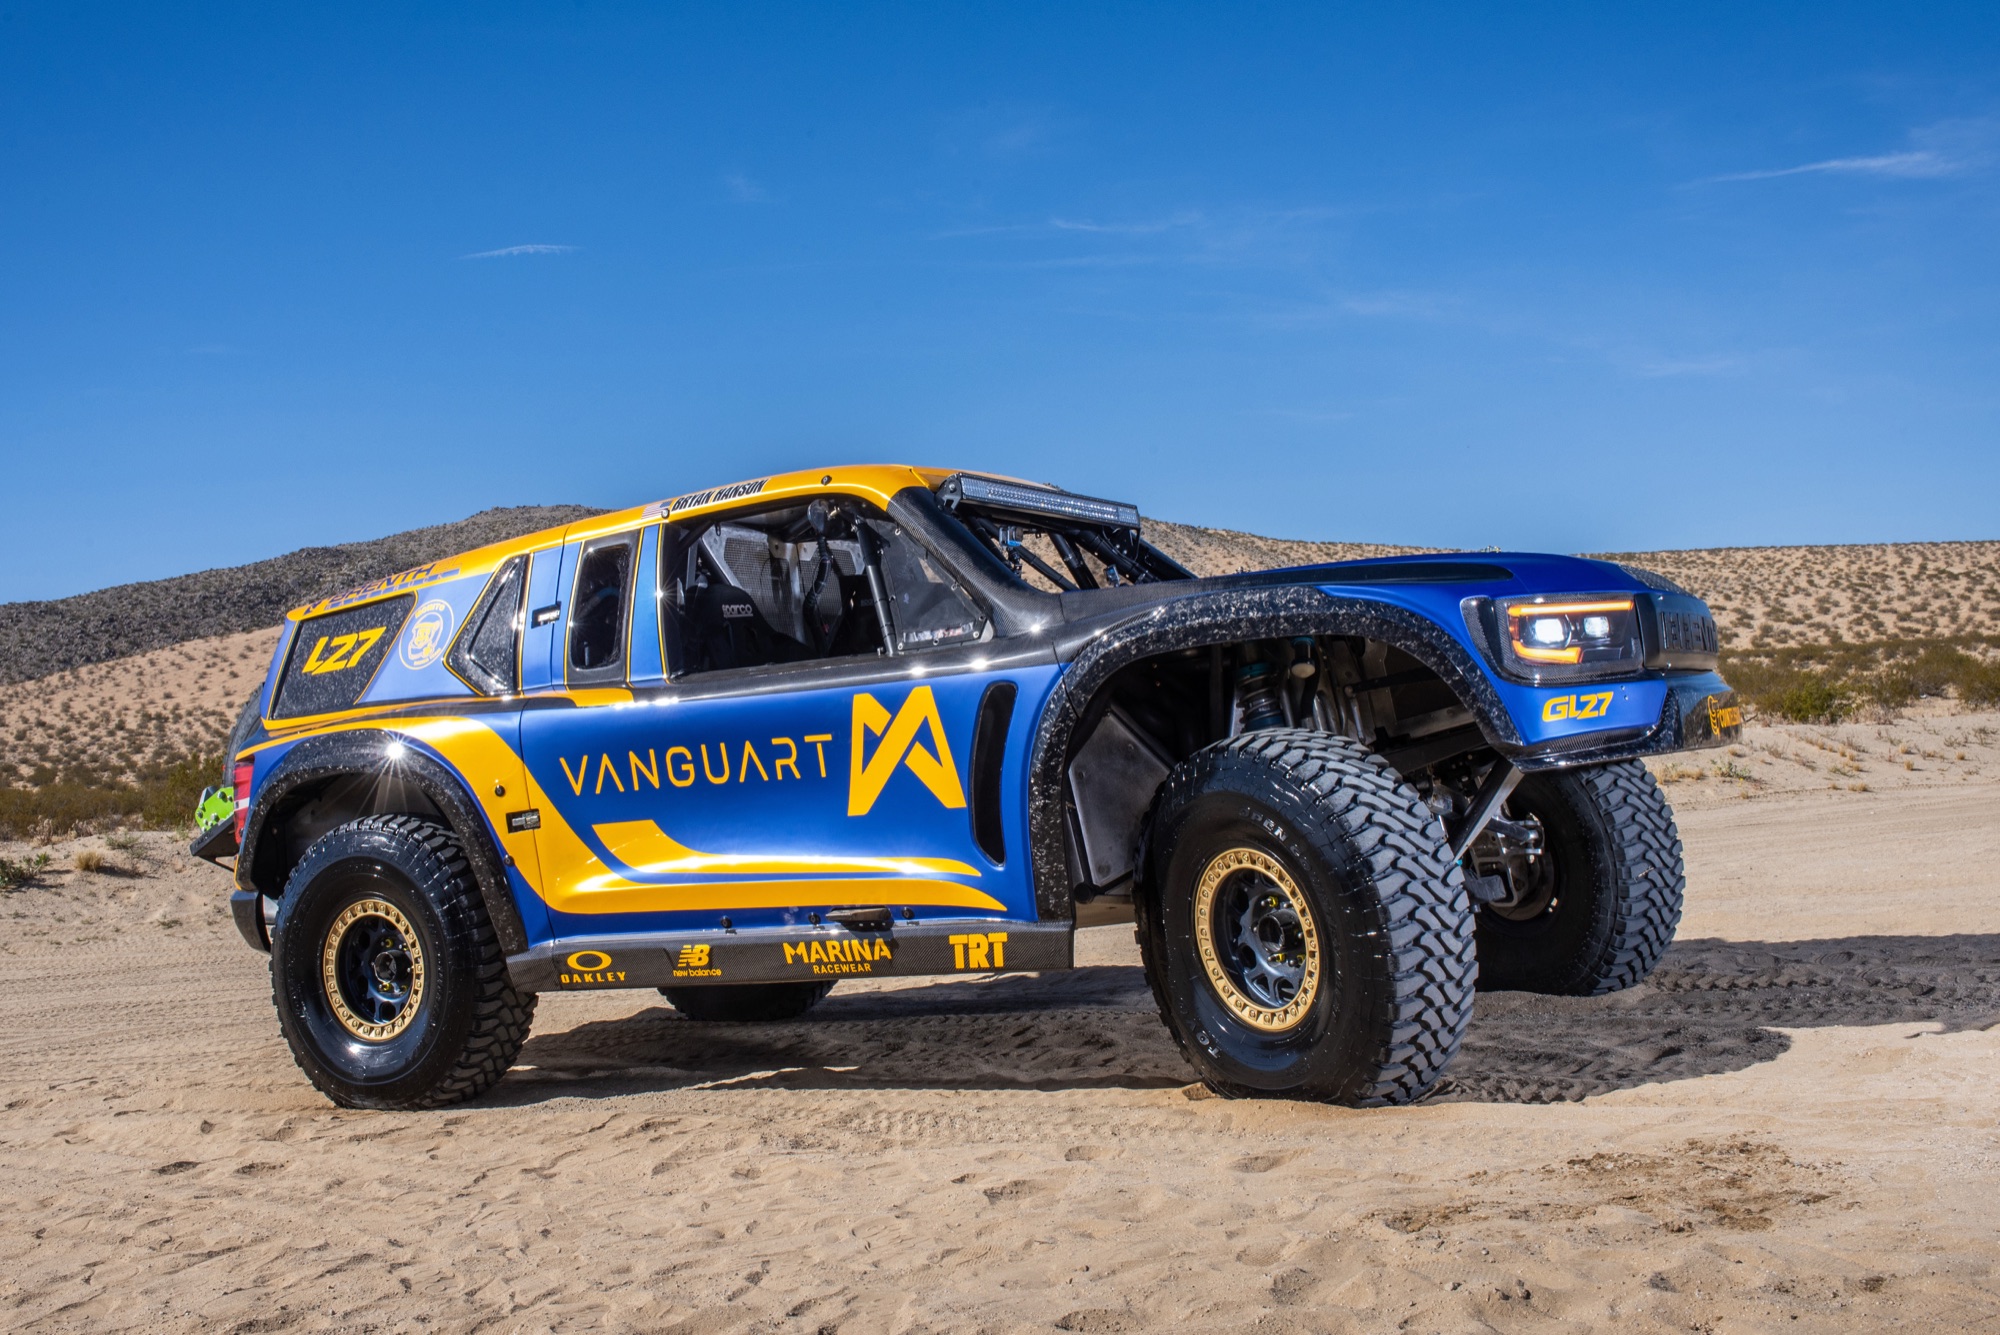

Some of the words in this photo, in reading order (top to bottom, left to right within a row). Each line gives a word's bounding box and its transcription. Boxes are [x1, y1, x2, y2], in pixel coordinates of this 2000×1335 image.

[671, 491, 715, 512] BRYAN
[712, 479, 768, 503] HANSON
[302, 626, 387, 675] L27
[1542, 691, 1614, 722] GL27
[559, 733, 832, 796] VANGUART
[782, 938, 893, 964] MARINA
[949, 932, 1008, 969] TRT
[560, 971, 627, 984] OAKLEY
[688, 968, 722, 977] balance
[813, 963, 872, 975] RACEWEAR
